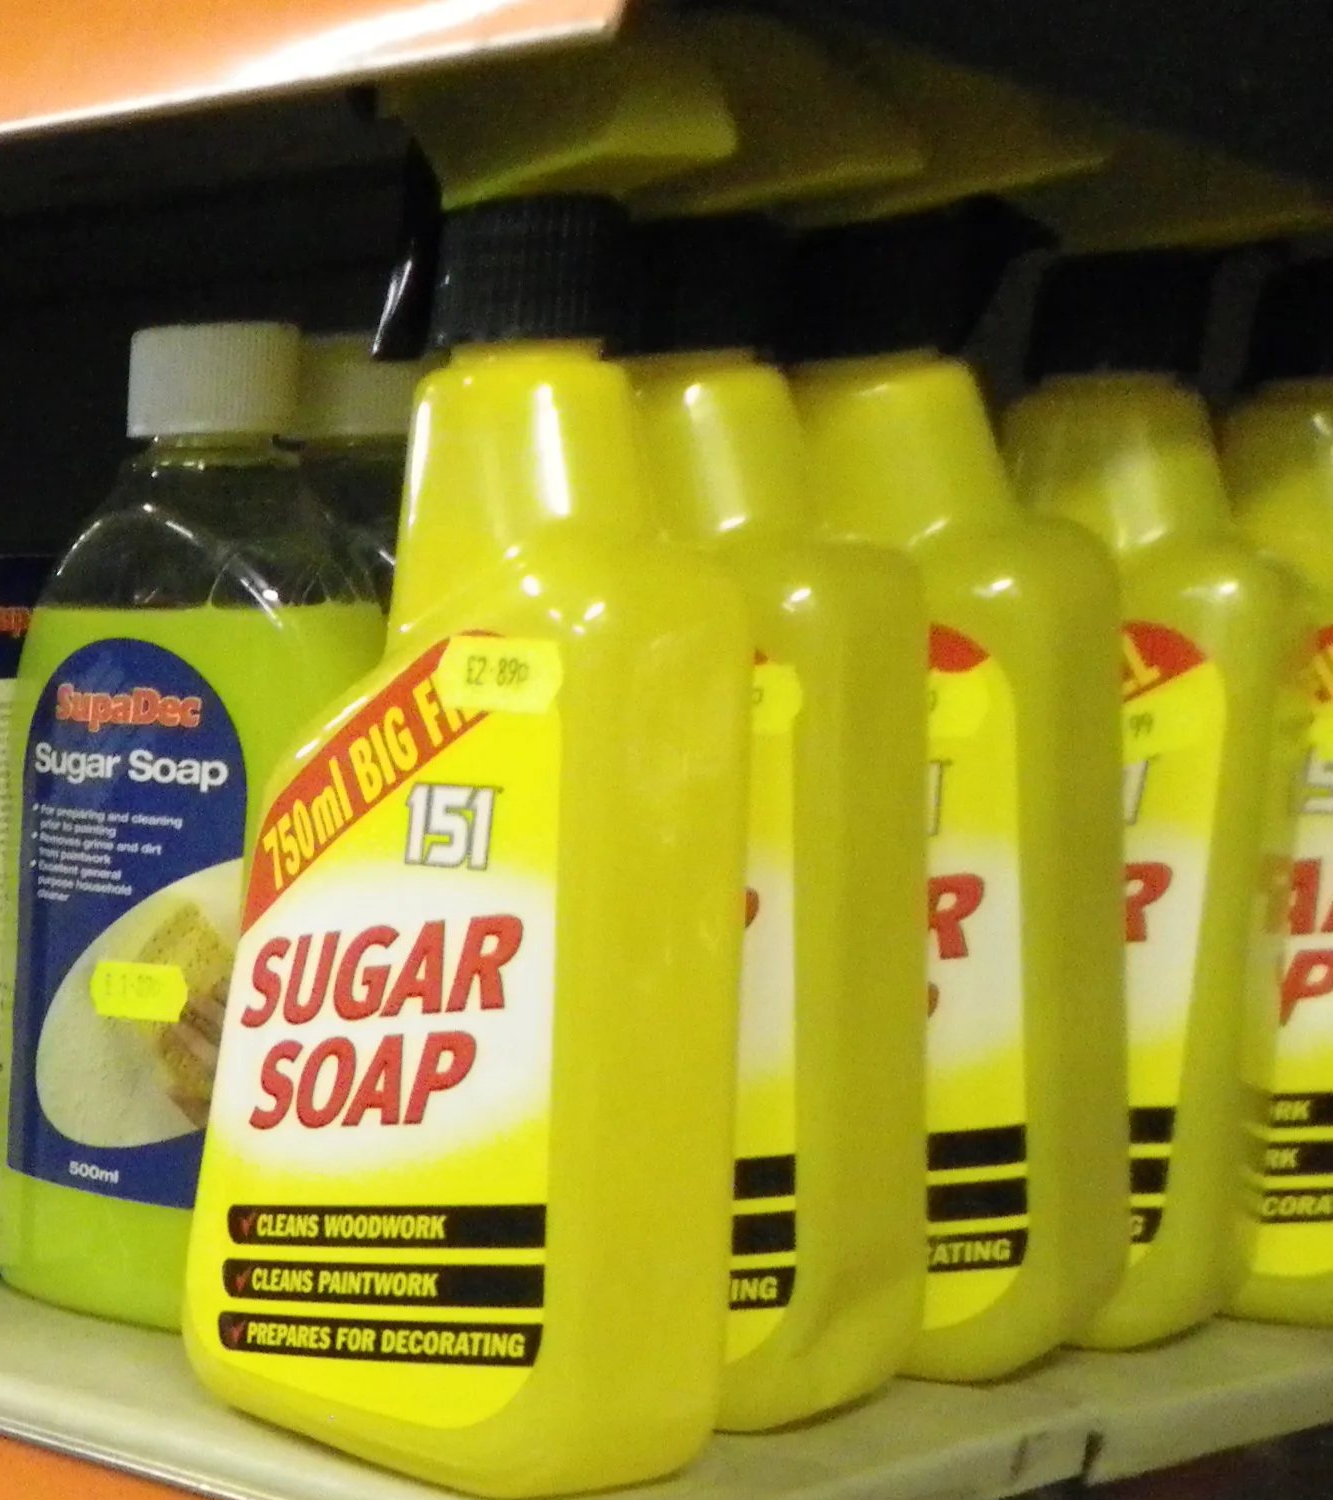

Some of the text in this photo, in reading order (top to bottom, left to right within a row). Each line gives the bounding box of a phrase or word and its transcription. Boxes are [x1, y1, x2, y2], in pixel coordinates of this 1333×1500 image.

[56, 683, 202, 733] SupaDec
[34, 741, 228, 794] Sugar Soap
[349, 706, 419, 797] BIG
[132, 813, 182, 830] cleaning
[404, 783, 492, 870] 151
[241, 914, 524, 1027] SUGAR
[249, 1030, 477, 1130] SOAP
[68, 1159, 120, 1185] 500ml
[256, 1212, 446, 1241] CLEANS WOODWORK
[250, 1268, 438, 1298] CLEANS PAINTWORK
[246, 1320, 525, 1359] PREPARES FOR DECORATING
